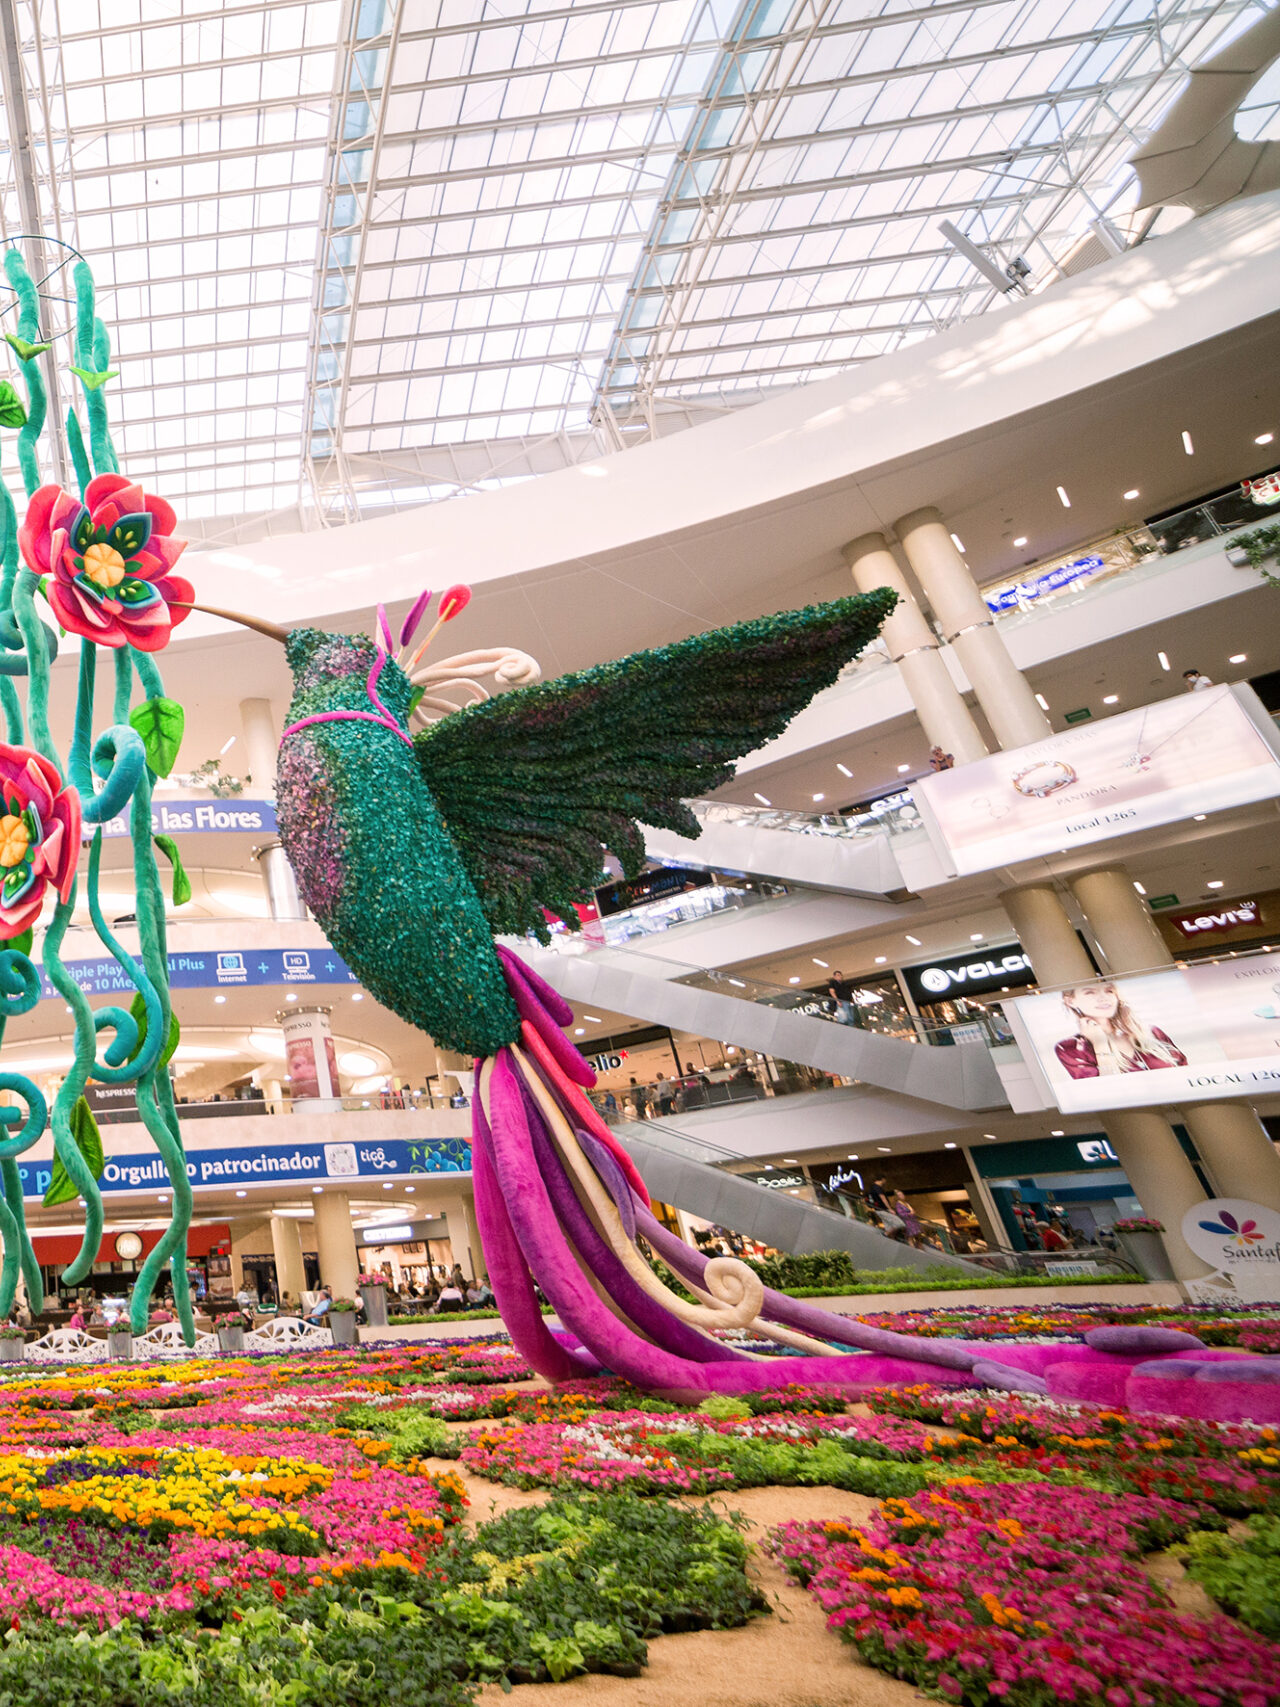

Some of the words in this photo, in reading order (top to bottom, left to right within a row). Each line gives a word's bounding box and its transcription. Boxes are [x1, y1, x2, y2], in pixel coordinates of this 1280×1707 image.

[161, 806, 193, 830] las
[195, 805, 262, 829] Flores
[1066, 817, 1101, 834] Local
[1104, 808, 1137, 824] 1265
[97, 963, 123, 977] Play
[180, 958, 205, 971] Plus
[290, 956, 303, 965] HD
[95, 978, 109, 990] 10
[112, 976, 138, 990] Meg
[218, 975, 247, 983] Internet
[1187, 1073, 1246, 1089] LOCAL
[103, 1159, 197, 1185] Orgulloo
[201, 1151, 321, 1180] patrocinador
